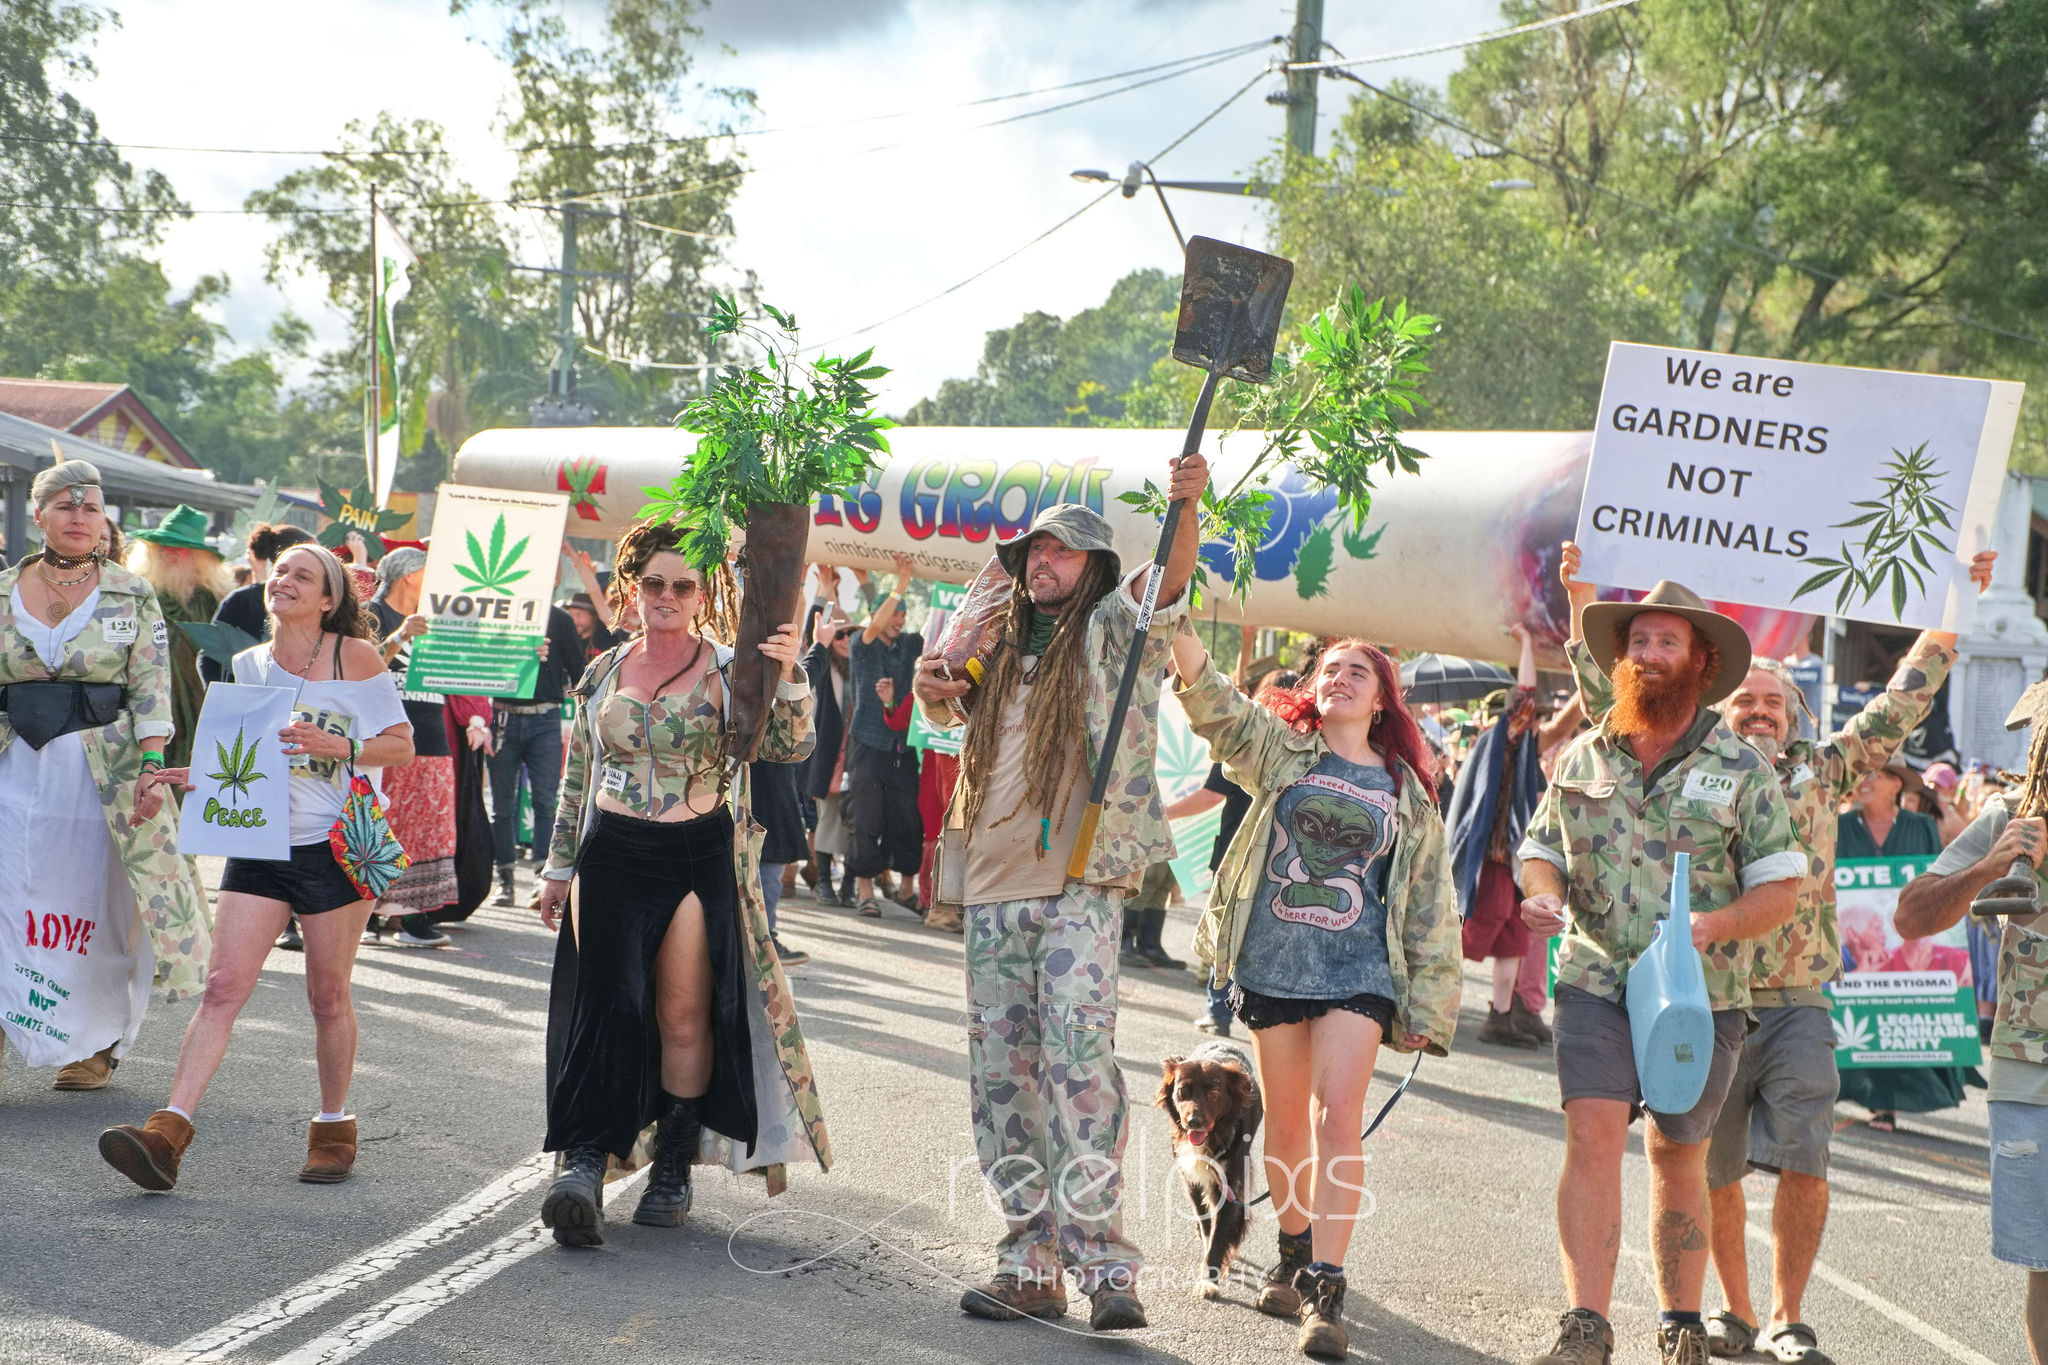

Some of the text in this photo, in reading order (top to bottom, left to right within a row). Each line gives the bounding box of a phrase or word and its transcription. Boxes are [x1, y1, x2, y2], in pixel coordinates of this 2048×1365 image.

[1665, 356, 1795, 398] We are
[1611, 403, 1830, 455] GARDNERS
[1667, 462, 1753, 499] NOT
[338, 503, 379, 533] PAIN
[1591, 504, 1810, 558] CRIMINALS
[429, 593, 535, 621] VOTE 1
[937, 589, 967, 609] VO
[424, 617, 465, 628] EGALISE
[513, 623, 542, 633] PARTY
[1318, 778, 1345, 791] need
[203, 797, 267, 829] PEACE
[1308, 912, 1329, 926] FOR
[1330, 905, 1361, 928] weed
[25, 908, 97, 956] LOVE
[1835, 979, 1862, 990] END
[1865, 978, 1890, 989] THE
[6, 1011, 71, 1045] CLIMATE CHANGE
[1876, 1013, 1965, 1027] LEGALISE
[1877, 1025, 1978, 1039] CANNABIS
[1879, 1037, 1942, 1051] PARTY
